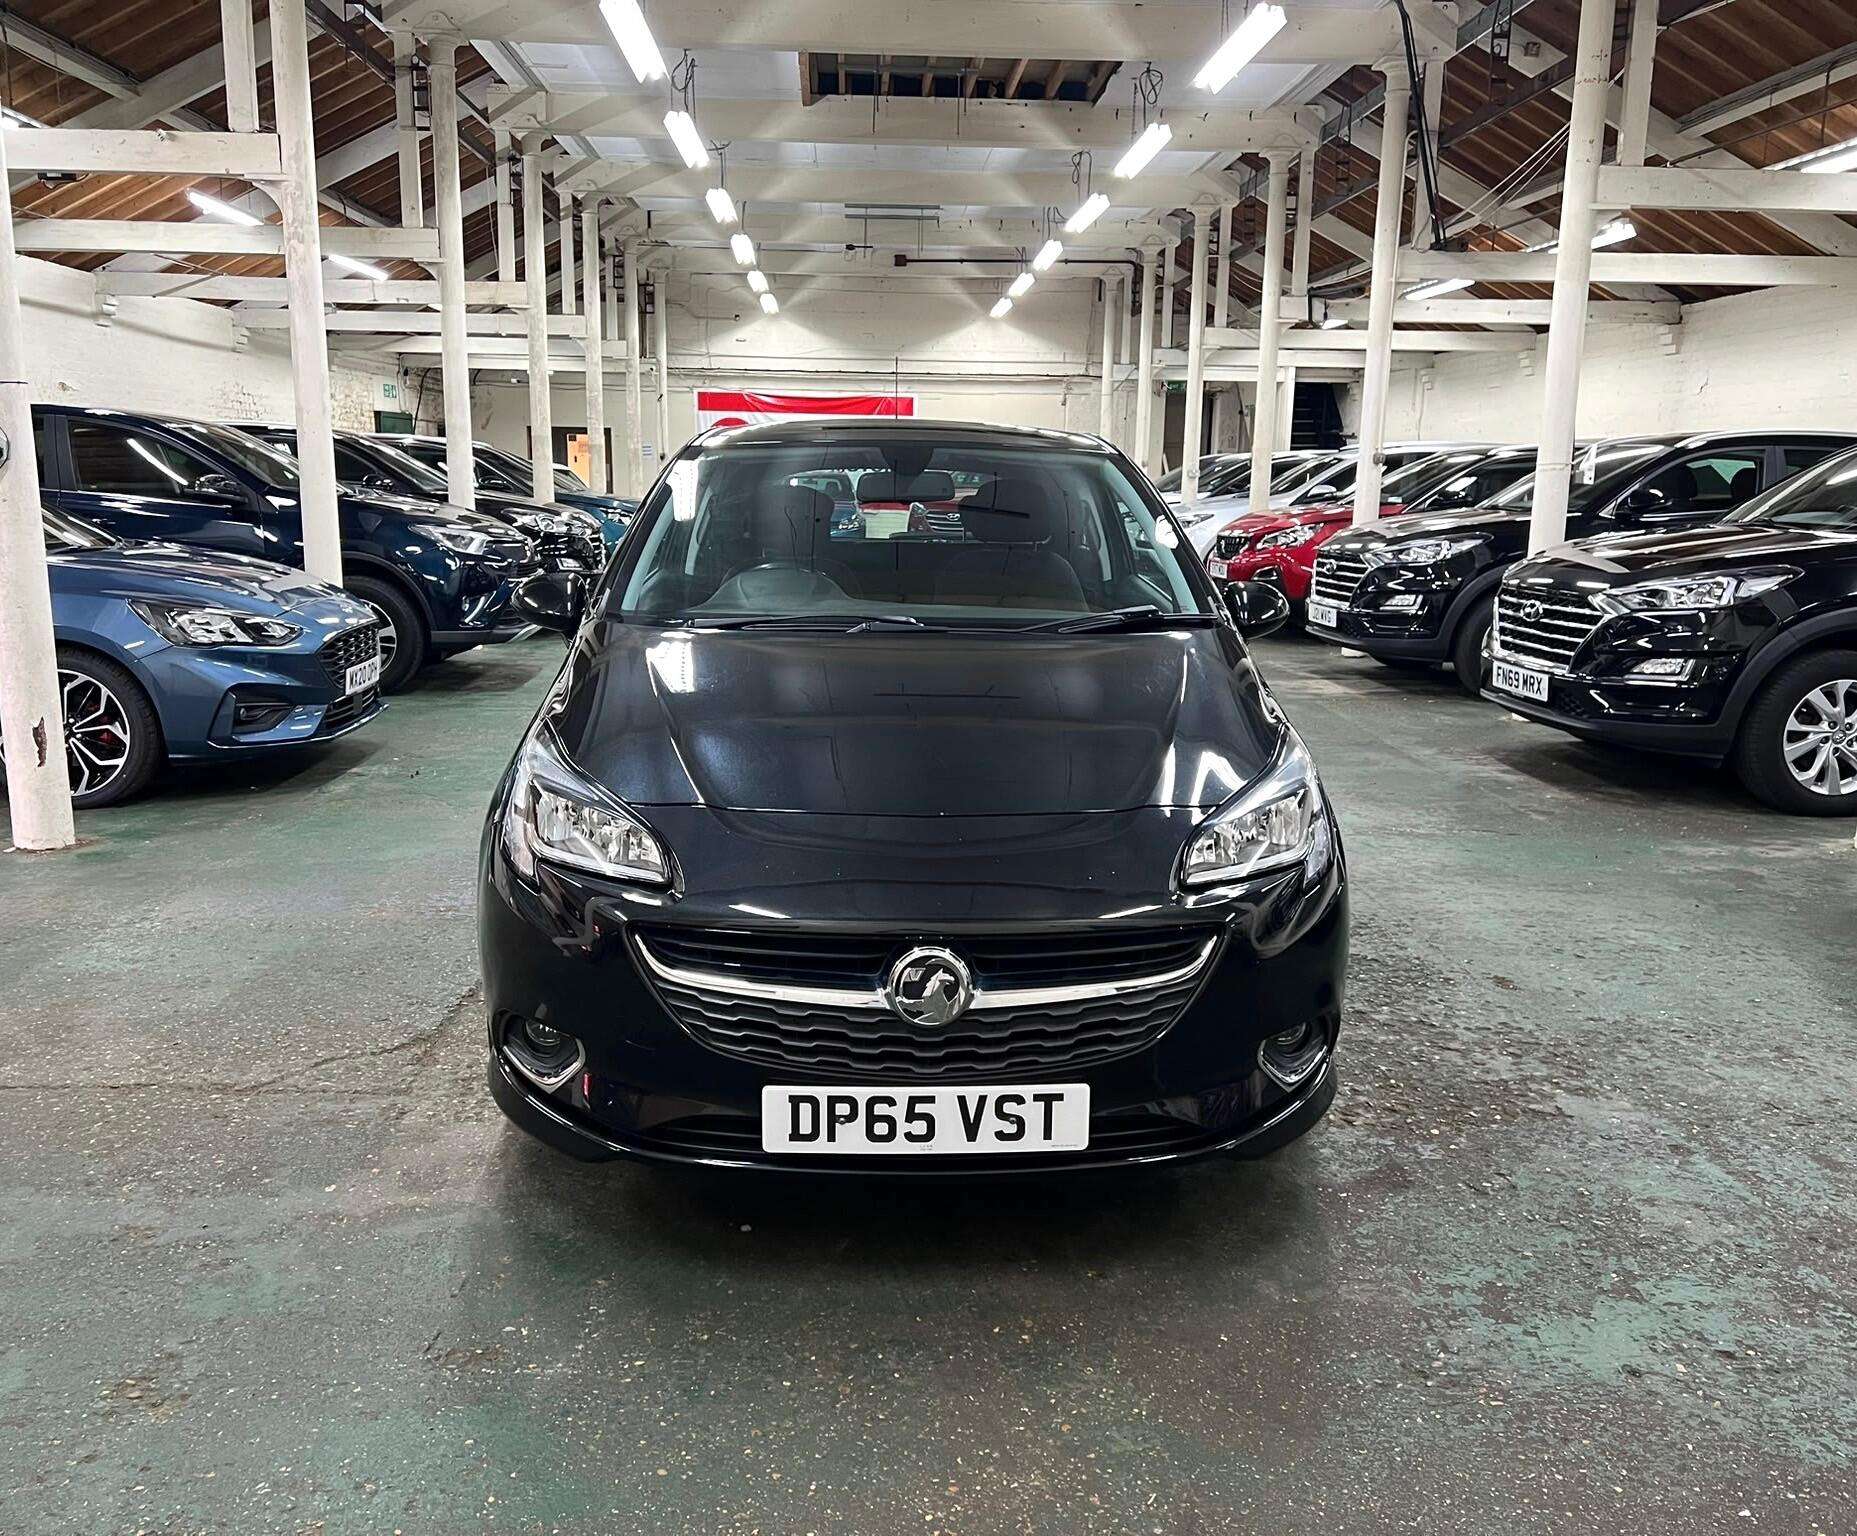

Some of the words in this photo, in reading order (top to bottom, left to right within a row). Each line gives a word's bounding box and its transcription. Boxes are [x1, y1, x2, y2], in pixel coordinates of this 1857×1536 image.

[1496, 666, 1520, 688] FN69
[1521, 673, 1542, 695] MRX
[788, 1095, 936, 1143] DP65
[956, 1093, 1065, 1142] VST
